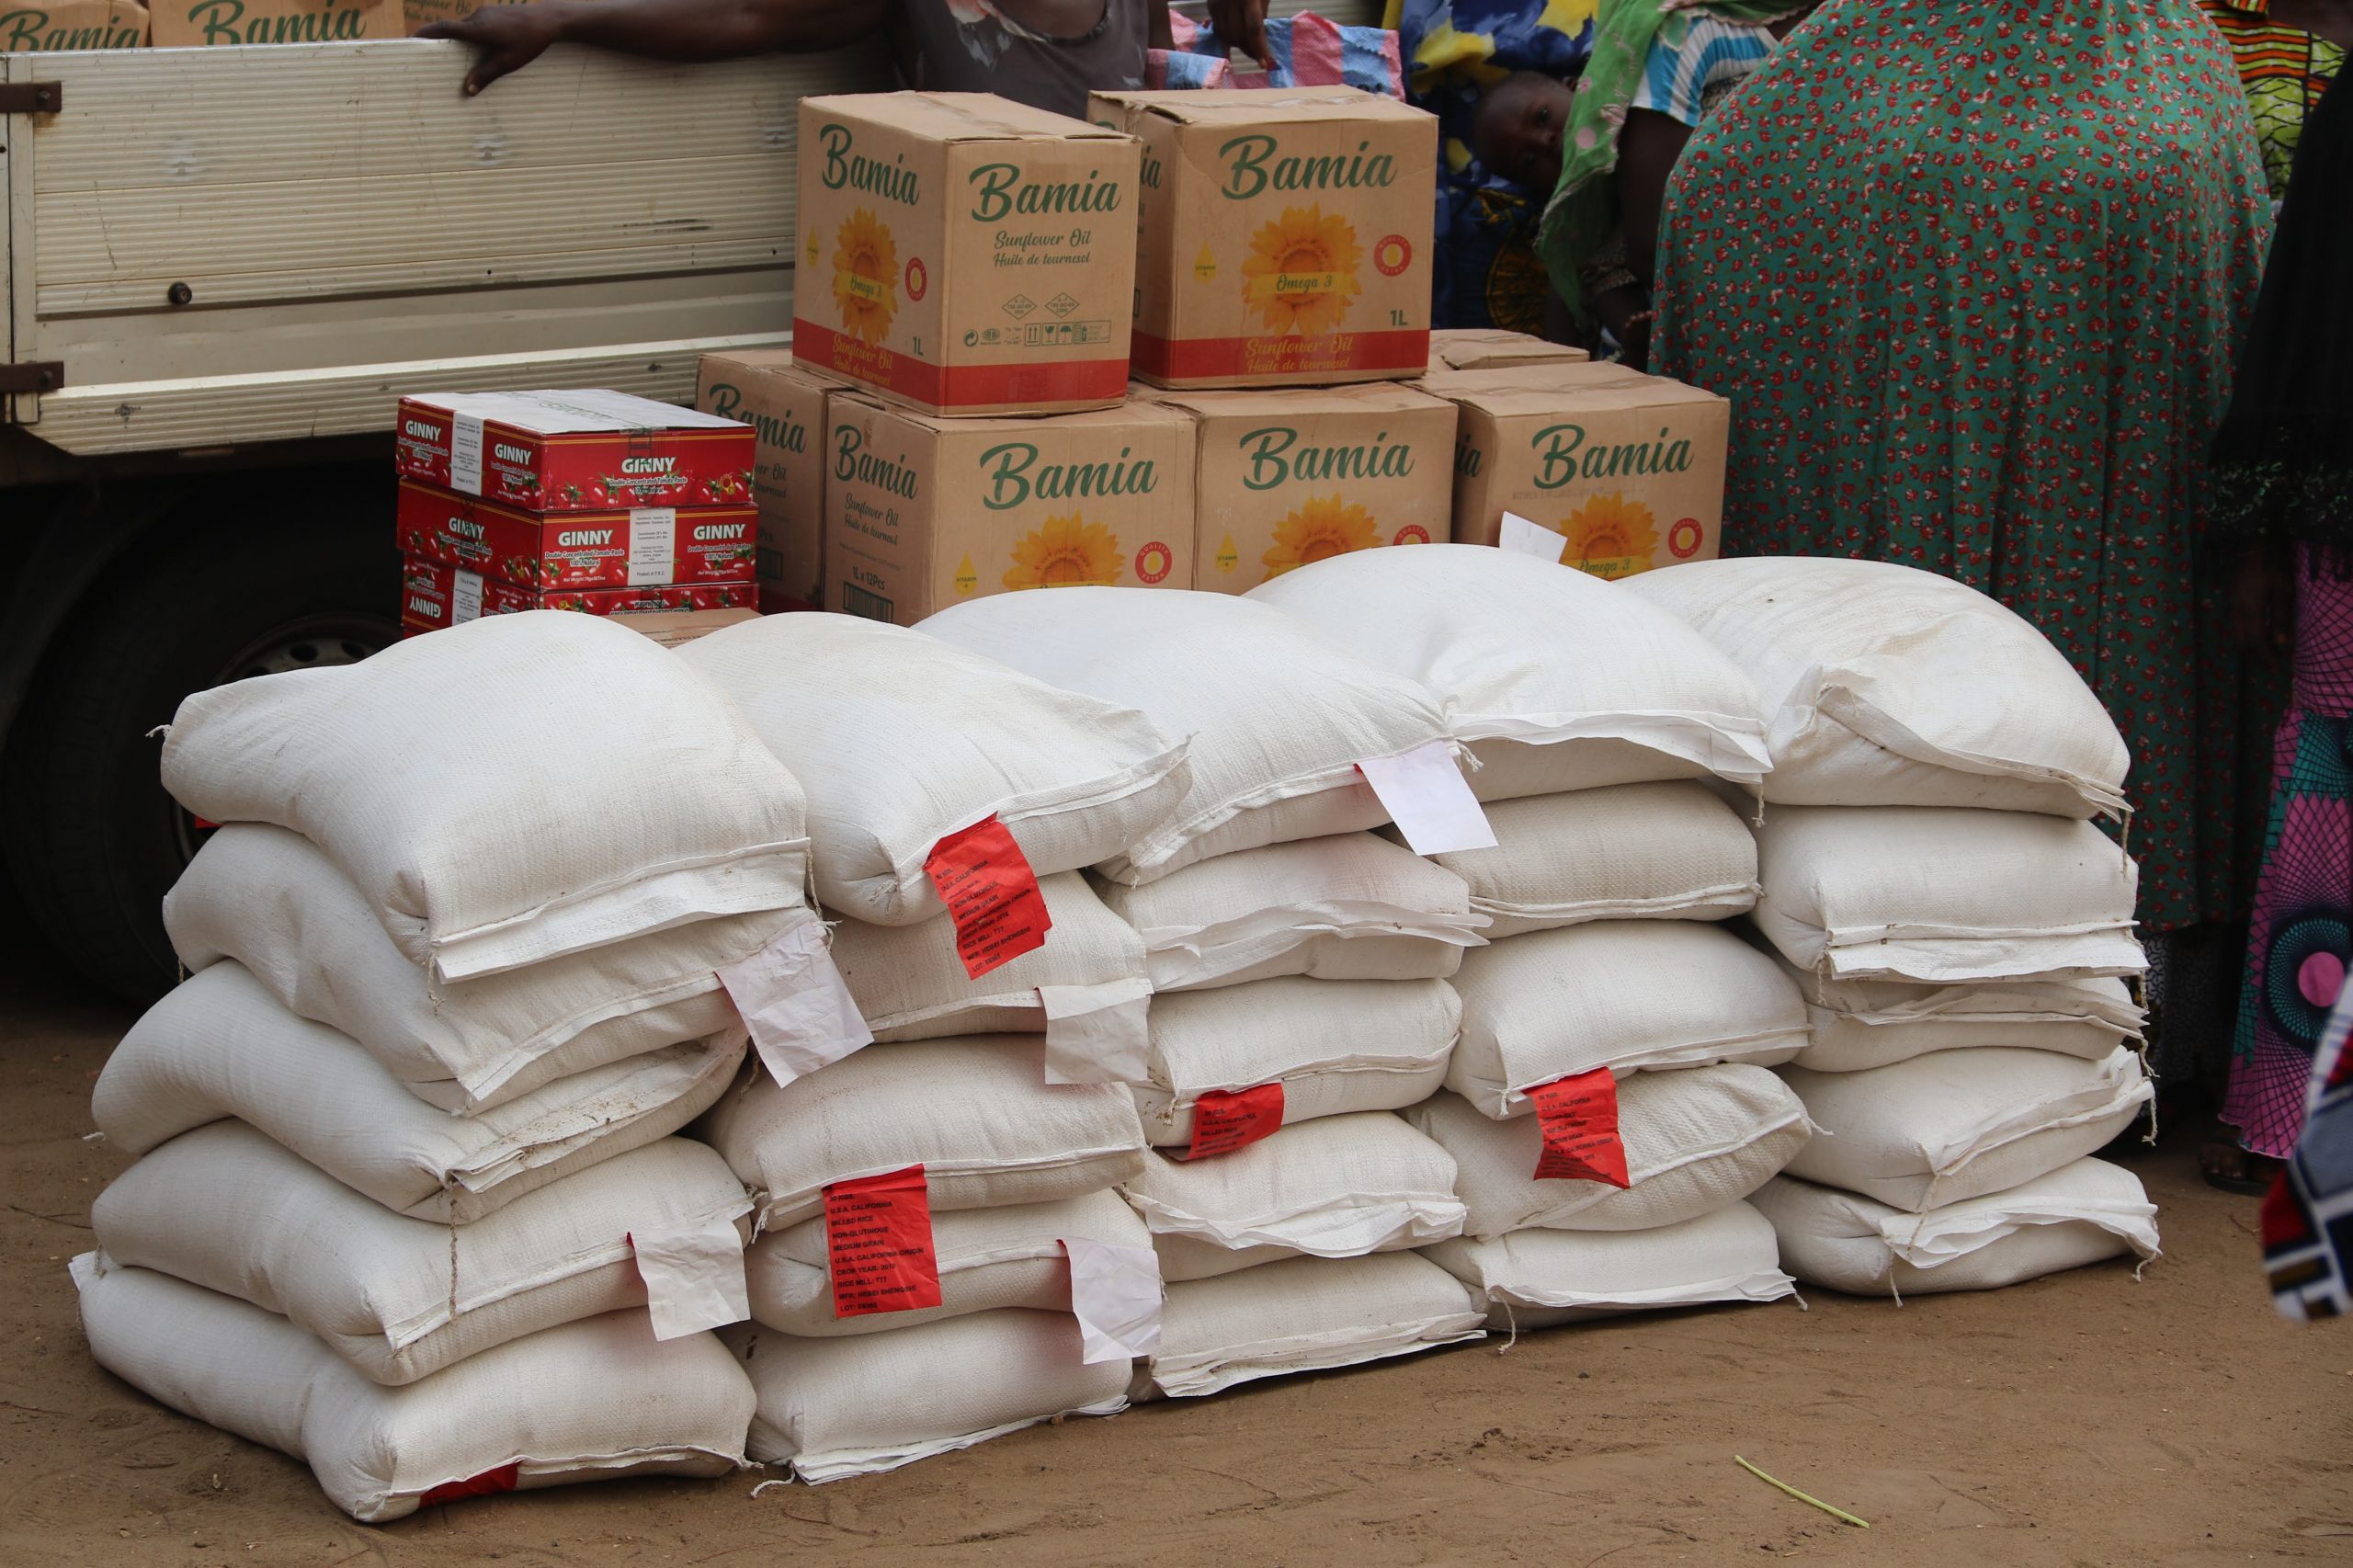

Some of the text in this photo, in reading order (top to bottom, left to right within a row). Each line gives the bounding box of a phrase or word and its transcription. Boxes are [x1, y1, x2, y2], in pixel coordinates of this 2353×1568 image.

[188, 0, 366, 45] Bamia
[820, 124, 919, 206] Bamia
[1220, 135, 1397, 200] Bamia
[970, 164, 1120, 222] Bamia
[995, 228, 1091, 251] Sunflower Oil
[994, 252, 1091, 267] Huile de tournesol
[850, 276, 882, 300] Omega 3
[1277, 275, 1333, 293] Omega 3
[1390, 310, 1408, 326] 1L
[833, 333, 892, 370] Sunflower Oil
[914, 336, 924, 356] 1L
[1245, 335, 1353, 358] Sunflower Oil
[1247, 358, 1350, 373] Huile de tournesol
[405, 420, 441, 441] GINNY
[494, 443, 532, 465] GINNY
[835, 425, 917, 499] Bamia
[1239, 427, 1415, 491] Bamia
[1532, 425, 1695, 489] Bamia
[621, 457, 676, 473] GINNY
[610, 479, 626, 487] Double
[627, 477, 656, 485] Concentrated
[980, 443, 1158, 510] Bamia
[846, 493, 899, 527] Sunflower Oil
[449, 517, 485, 540] GINNY
[693, 523, 745, 540] GINNY
[845, 514, 860, 531] Huile
[861, 523, 869, 533] de
[558, 529, 613, 546] GINNY
[1398, 527, 1427, 543] QUALITY
[563, 550, 593, 558] Concentrated
[1139, 543, 1169, 557] QUALITY
[1579, 559, 1631, 577] Omega 3
[853, 565, 860, 581] 1L
[866, 572, 885, 591] 12Pcs
[957, 575, 976, 584] VITAMIN
[1141, 572, 1165, 584] EXTRA
[410, 597, 441, 618] GINNY
[962, 940, 976, 949] RICE
[972, 962, 985, 971] LOT:
[1559, 1096, 1591, 1108] CALIFORNIA
[852, 1201, 893, 1210] CALIFORNIA
[833, 1227, 889, 1238] NON-GLUTINOUS
[834, 1243, 861, 1251] MEDIUM
[858, 1252, 897, 1260] CALIFORNIA
[900, 1247, 925, 1256] ORIGIN
